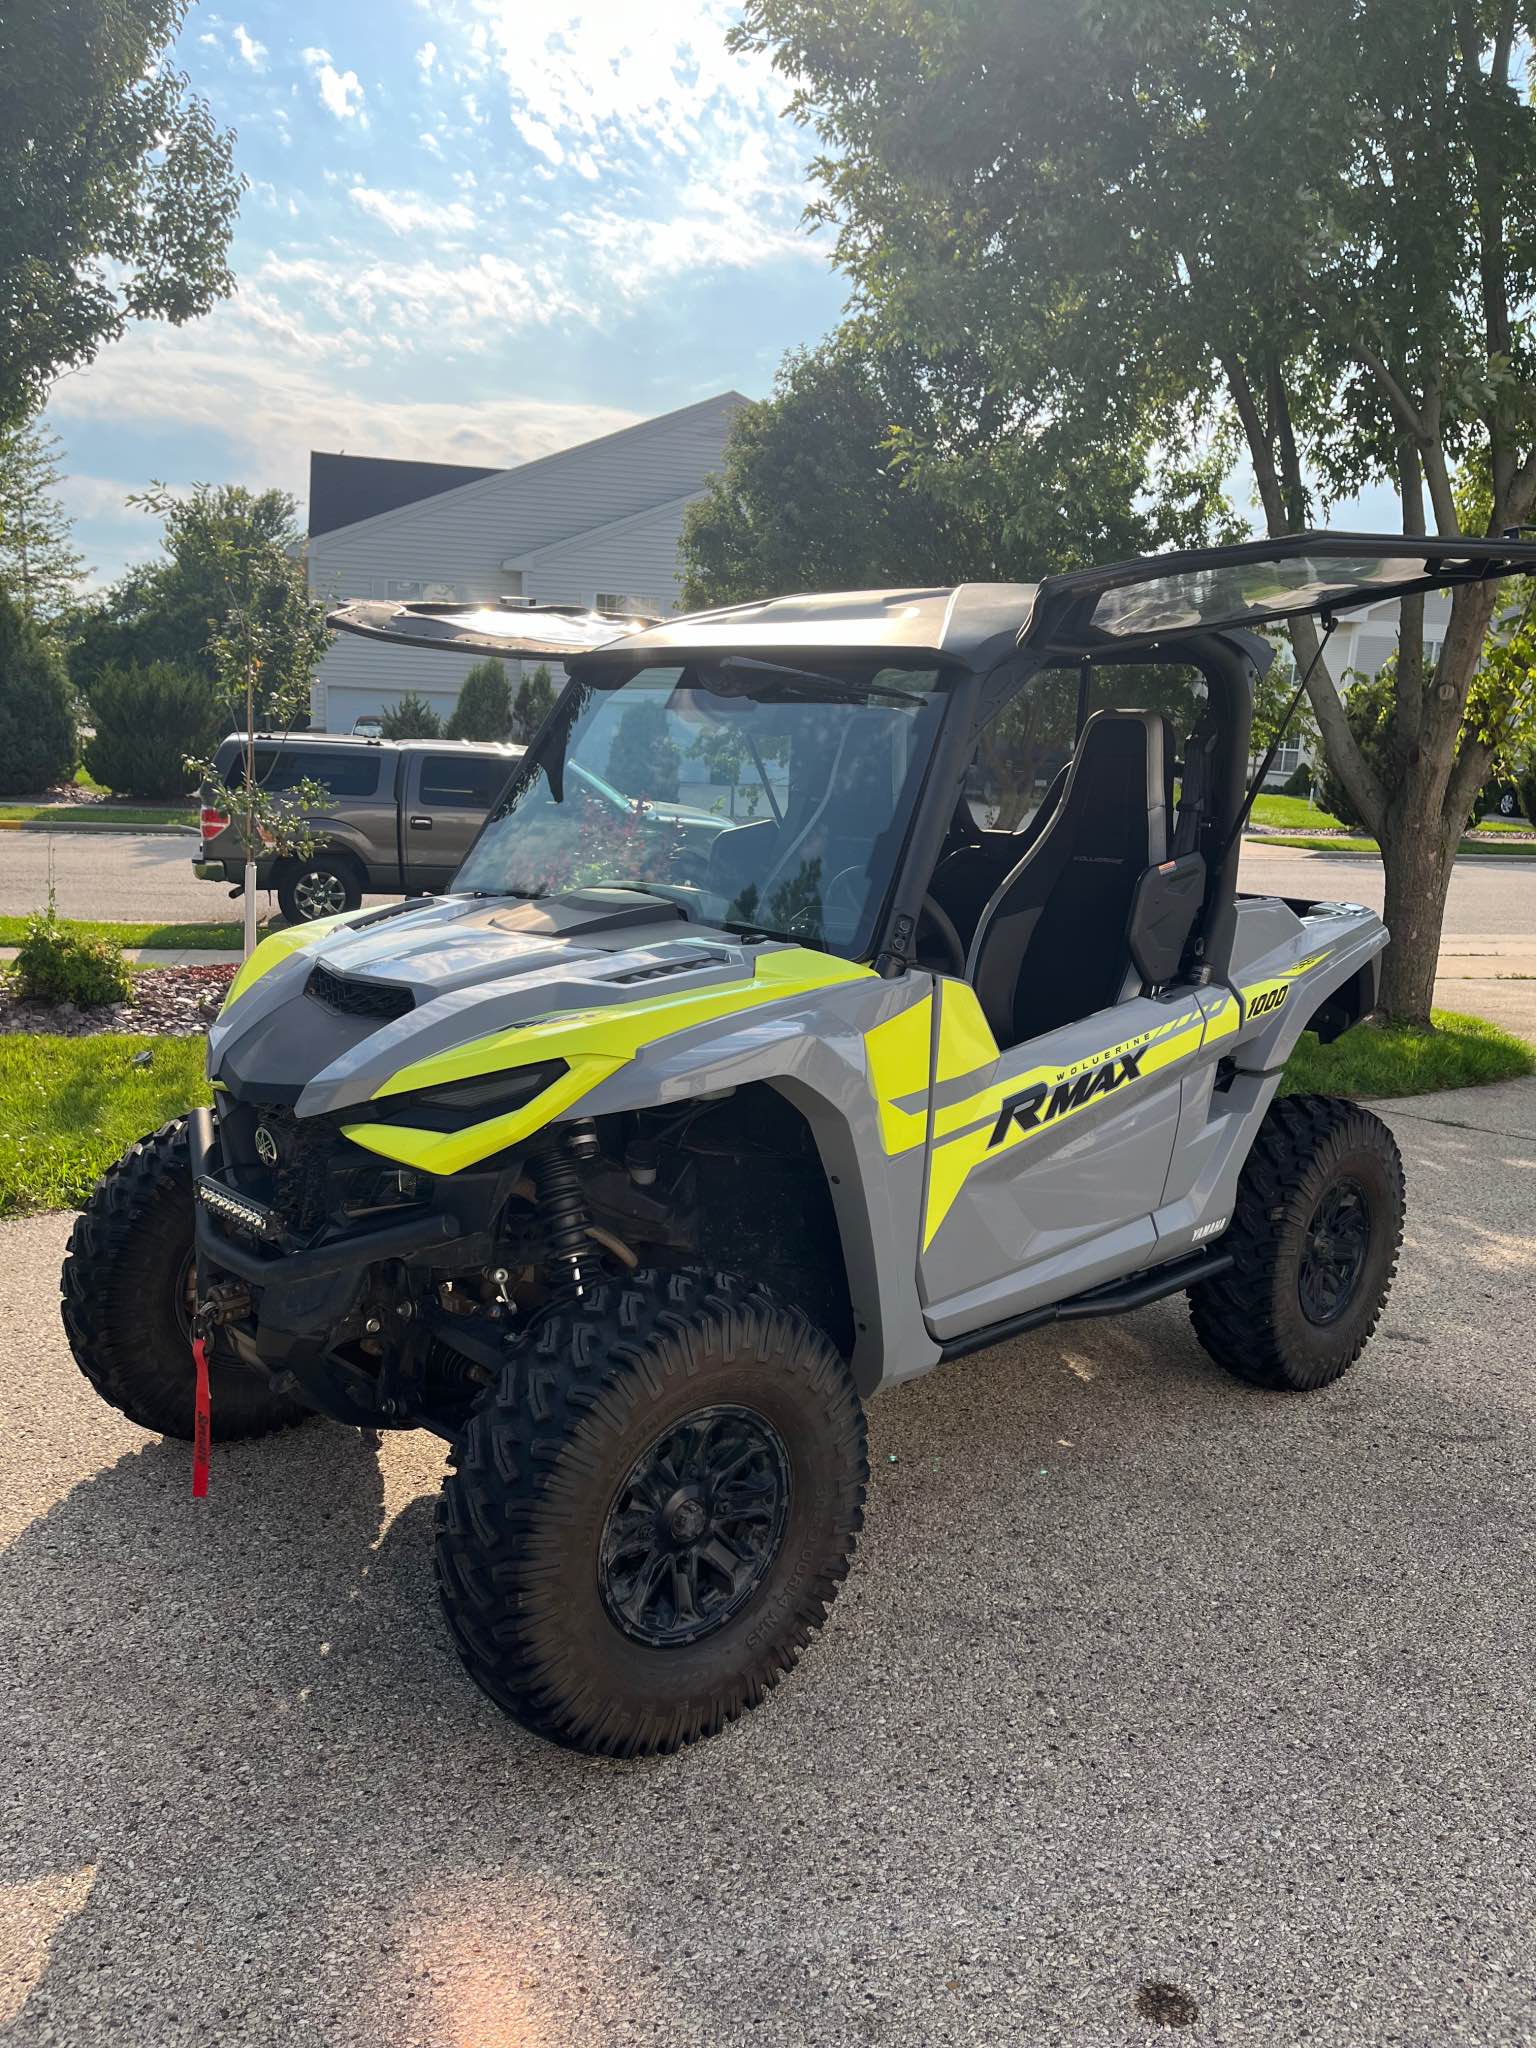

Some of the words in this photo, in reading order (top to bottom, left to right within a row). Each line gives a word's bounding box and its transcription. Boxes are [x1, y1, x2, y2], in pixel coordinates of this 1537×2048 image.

[1246, 984, 1289, 1020] 1000
[986, 1044, 1150, 1151] RMAX
[1191, 1217, 1226, 1242] YAMAHA
